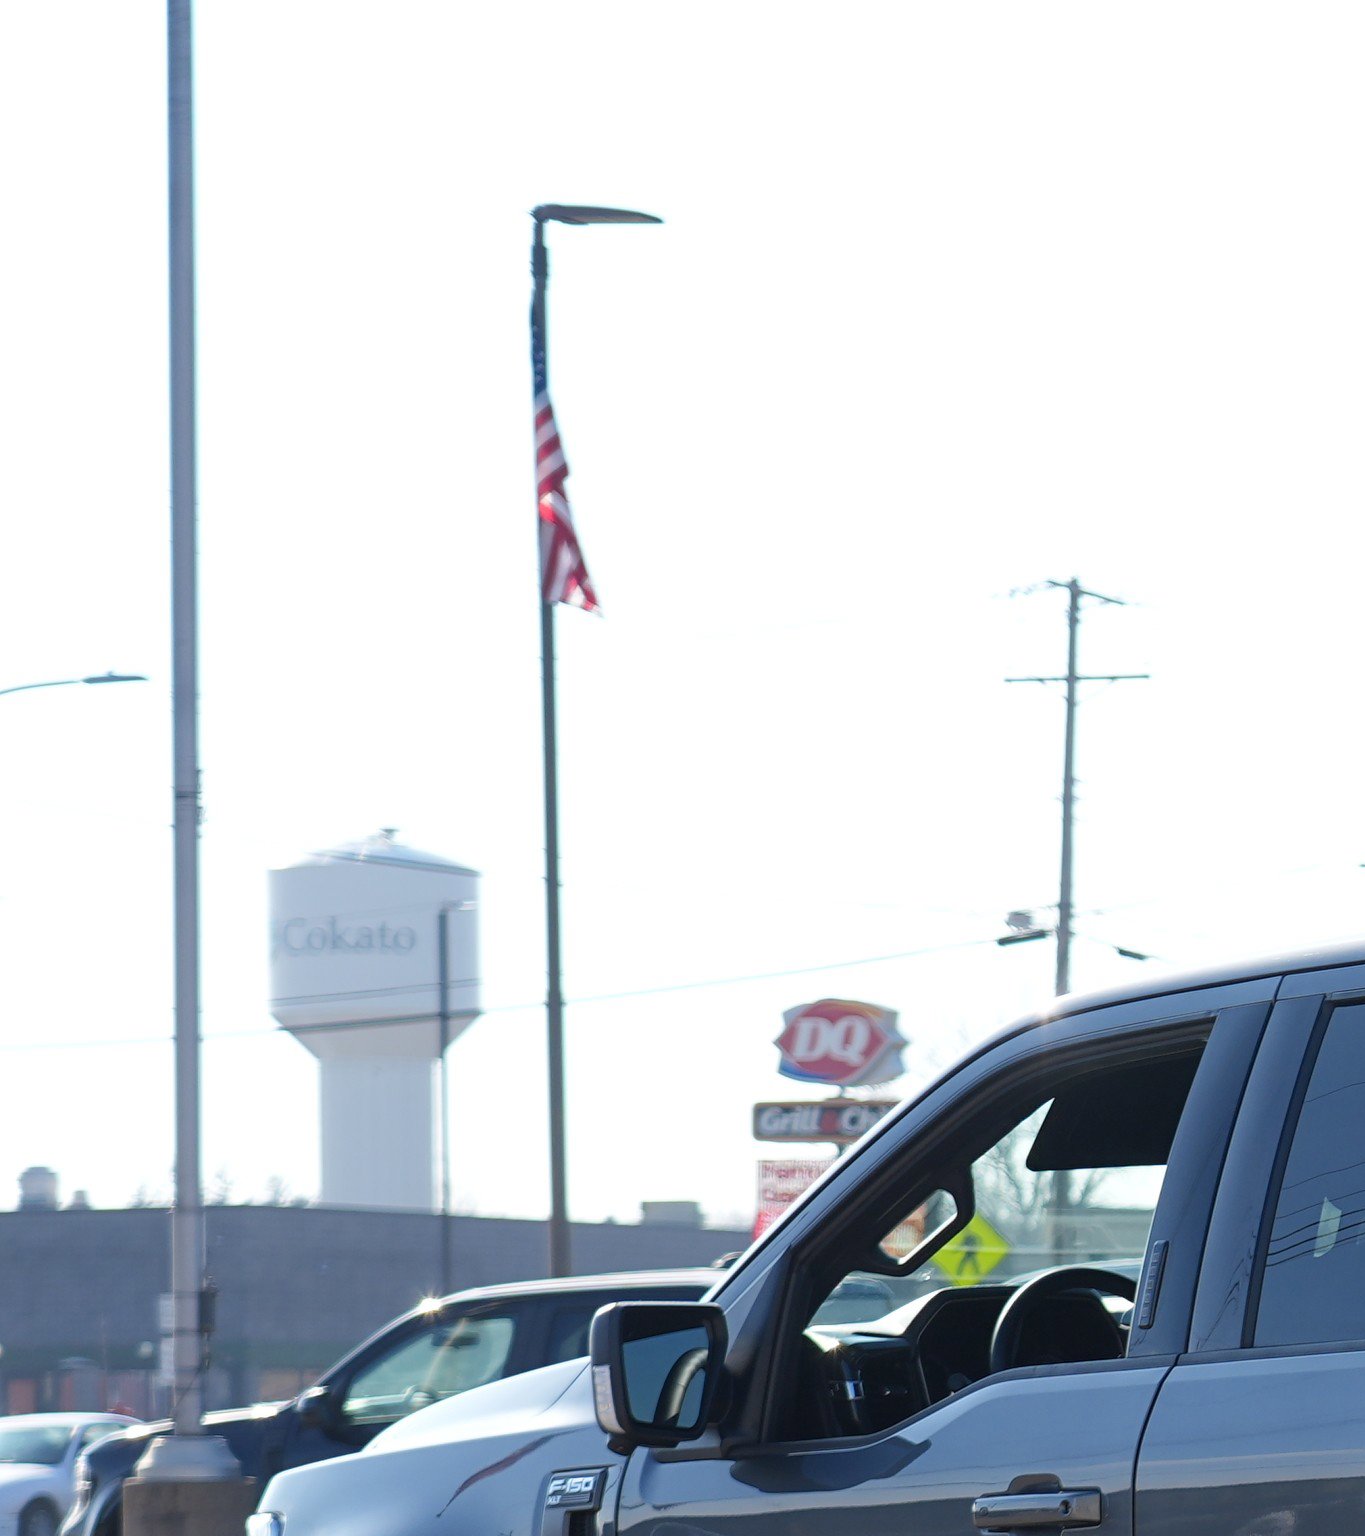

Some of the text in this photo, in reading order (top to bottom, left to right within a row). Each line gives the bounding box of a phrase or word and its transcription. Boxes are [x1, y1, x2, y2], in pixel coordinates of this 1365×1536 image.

[284, 915, 417, 956] Cokato
[792, 1014, 872, 1067] DQ
[760, 1105, 821, 1134] Grill
[547, 1476, 595, 1496] F-150
[547, 1495, 562, 1506] XLT
